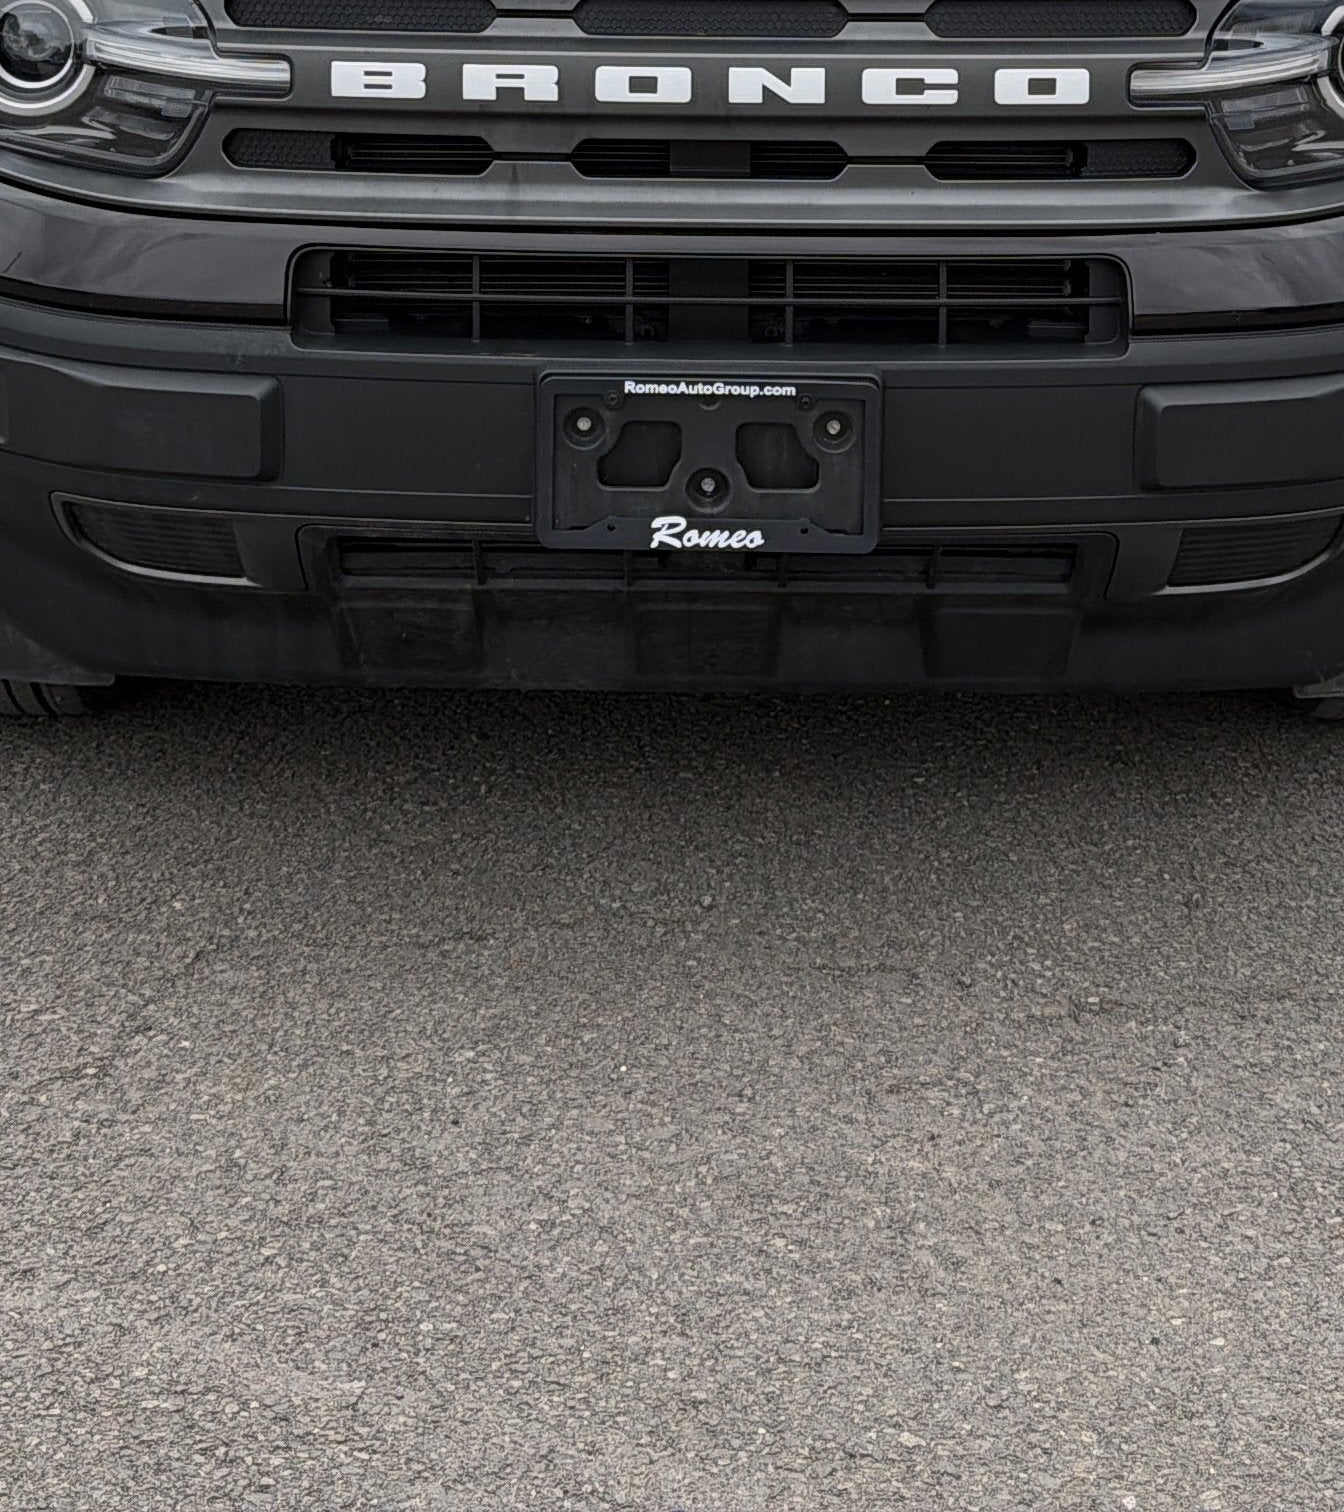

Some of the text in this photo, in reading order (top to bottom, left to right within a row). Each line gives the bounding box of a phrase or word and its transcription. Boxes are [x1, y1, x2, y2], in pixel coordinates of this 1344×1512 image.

[331, 61, 1090, 105] BRONCO
[624, 381, 797, 397] RomeoAutoGroup.com
[650, 516, 765, 548] Romeo
